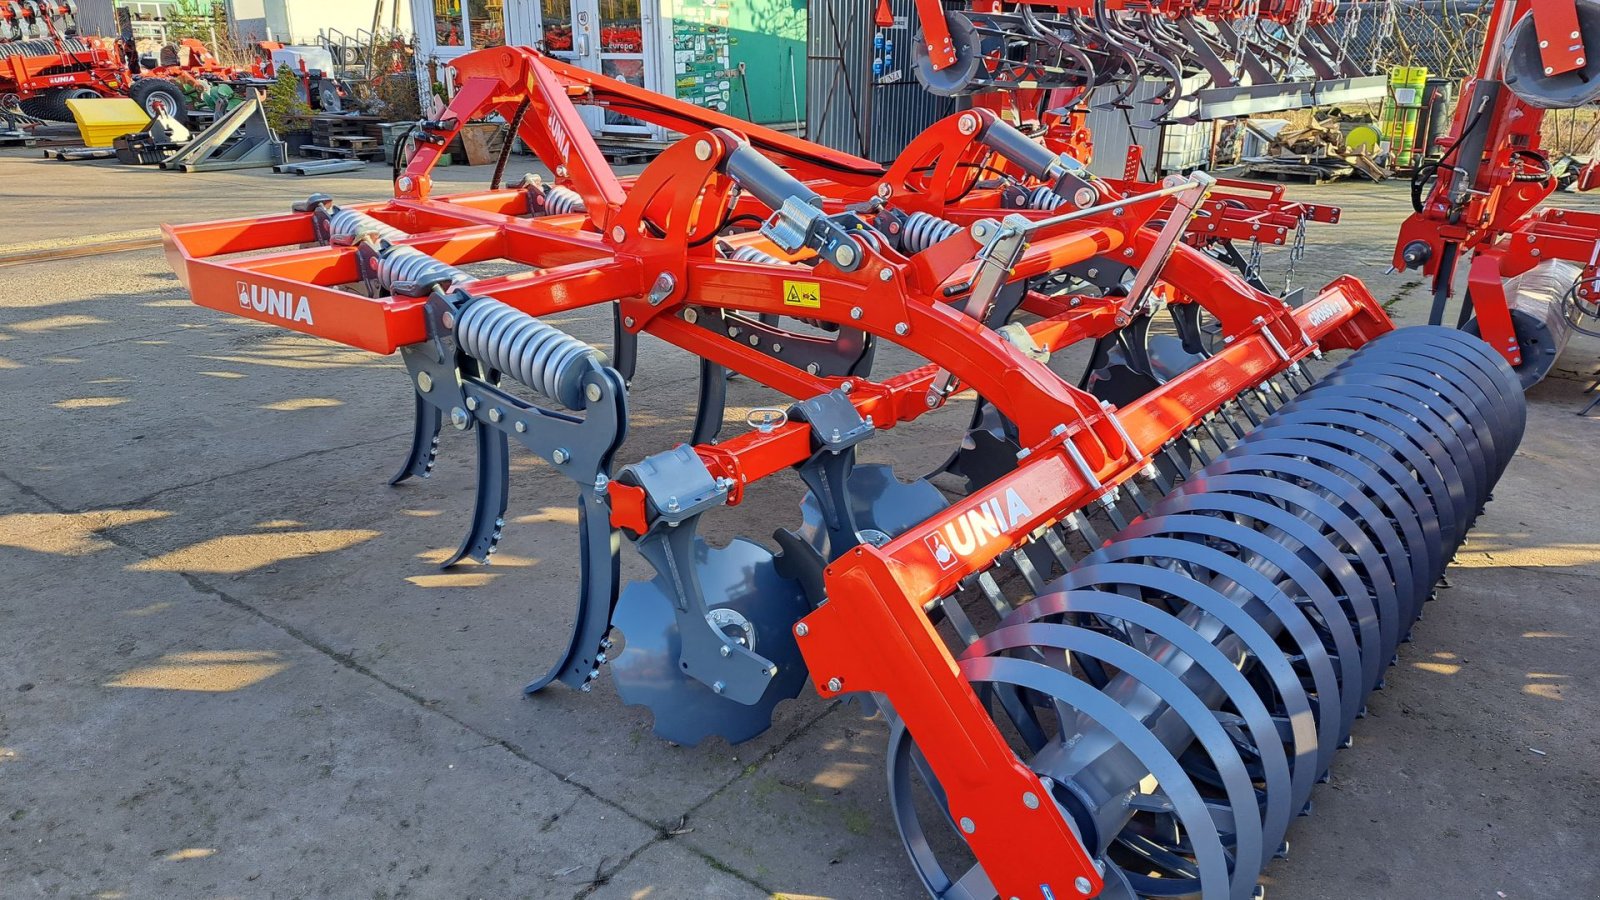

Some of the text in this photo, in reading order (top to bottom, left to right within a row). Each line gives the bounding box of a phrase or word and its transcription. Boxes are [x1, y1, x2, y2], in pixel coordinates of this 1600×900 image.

[609, 42, 633, 50] europa
[54, 75, 75, 83] UNIA
[551, 114, 570, 163] UNIA
[249, 285, 314, 326] UNIA
[1308, 302, 1334, 327] CROSS
[944, 487, 1033, 556] UNIA
